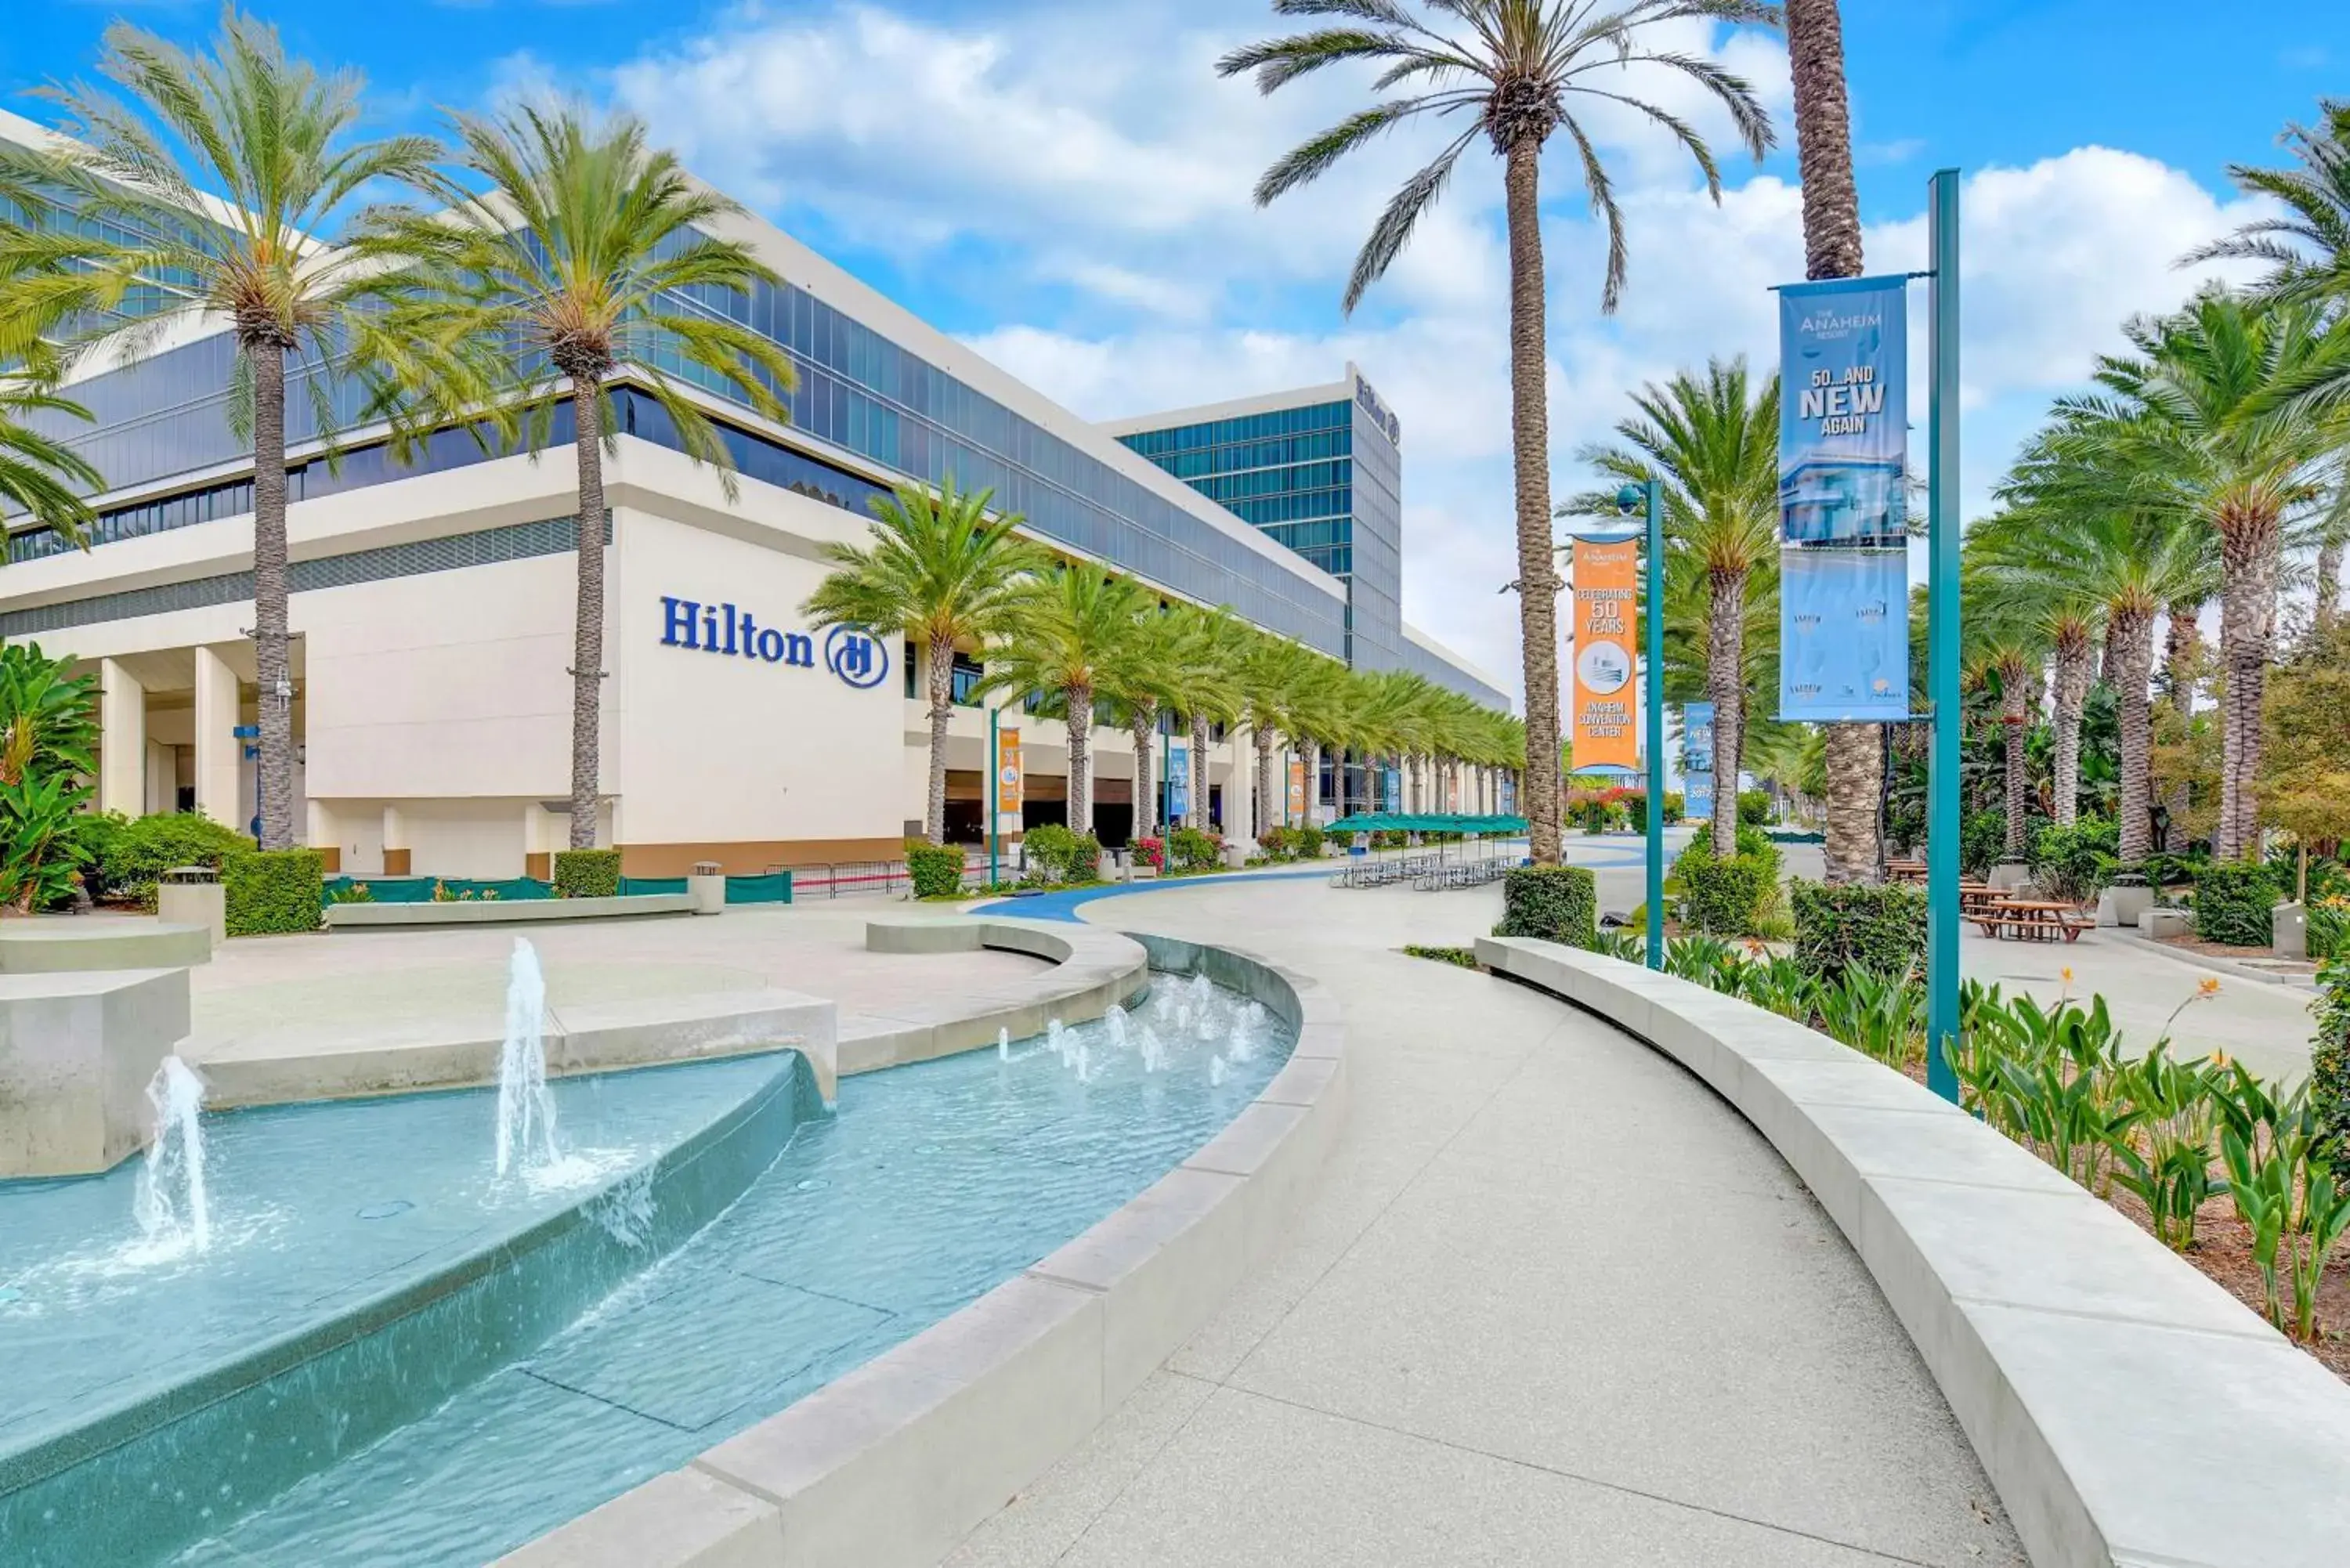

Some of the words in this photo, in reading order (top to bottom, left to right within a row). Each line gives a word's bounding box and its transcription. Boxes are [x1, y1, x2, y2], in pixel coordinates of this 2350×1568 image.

[1800, 314, 1881, 333] ANAHEIM
[1800, 383, 1885, 418] NEW
[1821, 416, 1866, 435] AGAIN
[1578, 589, 1632, 601] CELEBRATING
[1592, 600, 1619, 618] 50
[660, 595, 815, 668] Hilton
[1585, 617, 1625, 634] YEARS
[1589, 726, 1622, 738] CENTER
